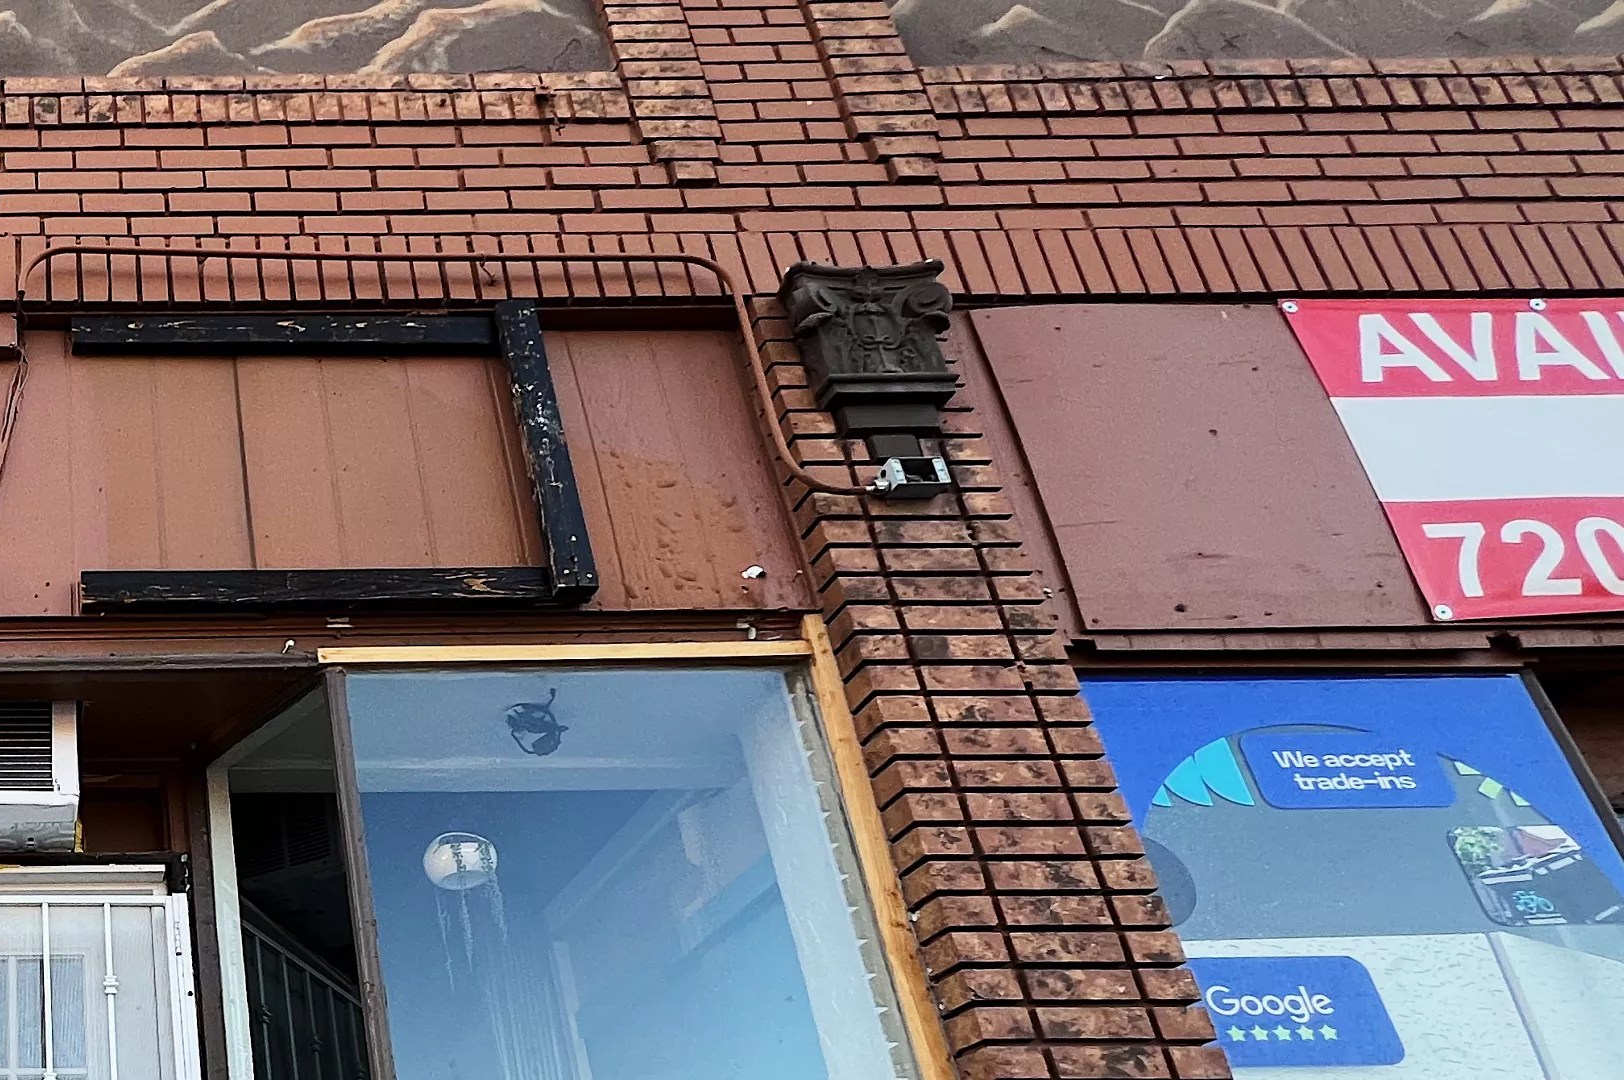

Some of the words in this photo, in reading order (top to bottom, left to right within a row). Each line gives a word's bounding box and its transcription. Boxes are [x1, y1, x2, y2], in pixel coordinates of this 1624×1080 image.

[1359, 311, 1624, 382] AVAI
[1272, 750, 1319, 768] We
[1322, 749, 1415, 771] accept
[1294, 771, 1417, 790] trade-ins
[1205, 985, 1335, 1023] Google
